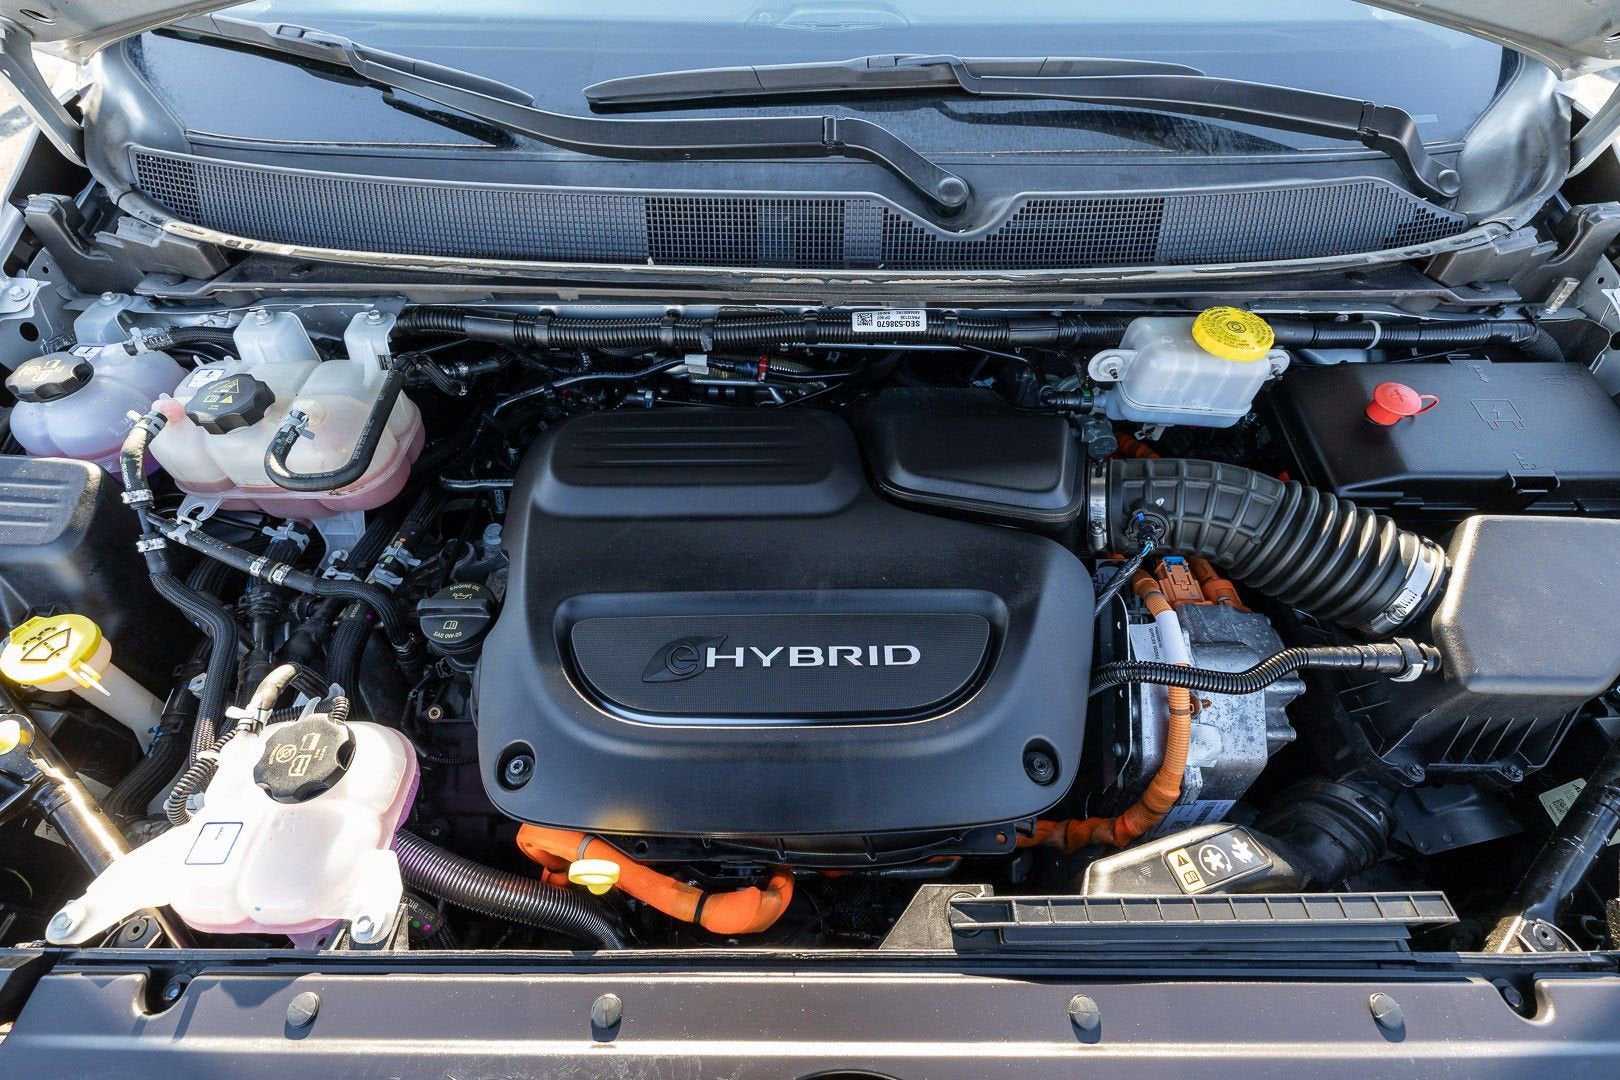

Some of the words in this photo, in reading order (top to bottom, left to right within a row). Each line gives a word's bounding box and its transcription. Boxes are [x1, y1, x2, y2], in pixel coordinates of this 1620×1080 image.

[876, 320, 921, 328] SEQ:538670
[449, 583, 472, 591] ENGINE
[471, 584, 481, 592] OIL
[432, 630, 444, 639] SAE
[444, 631, 463, 639] 0W-20
